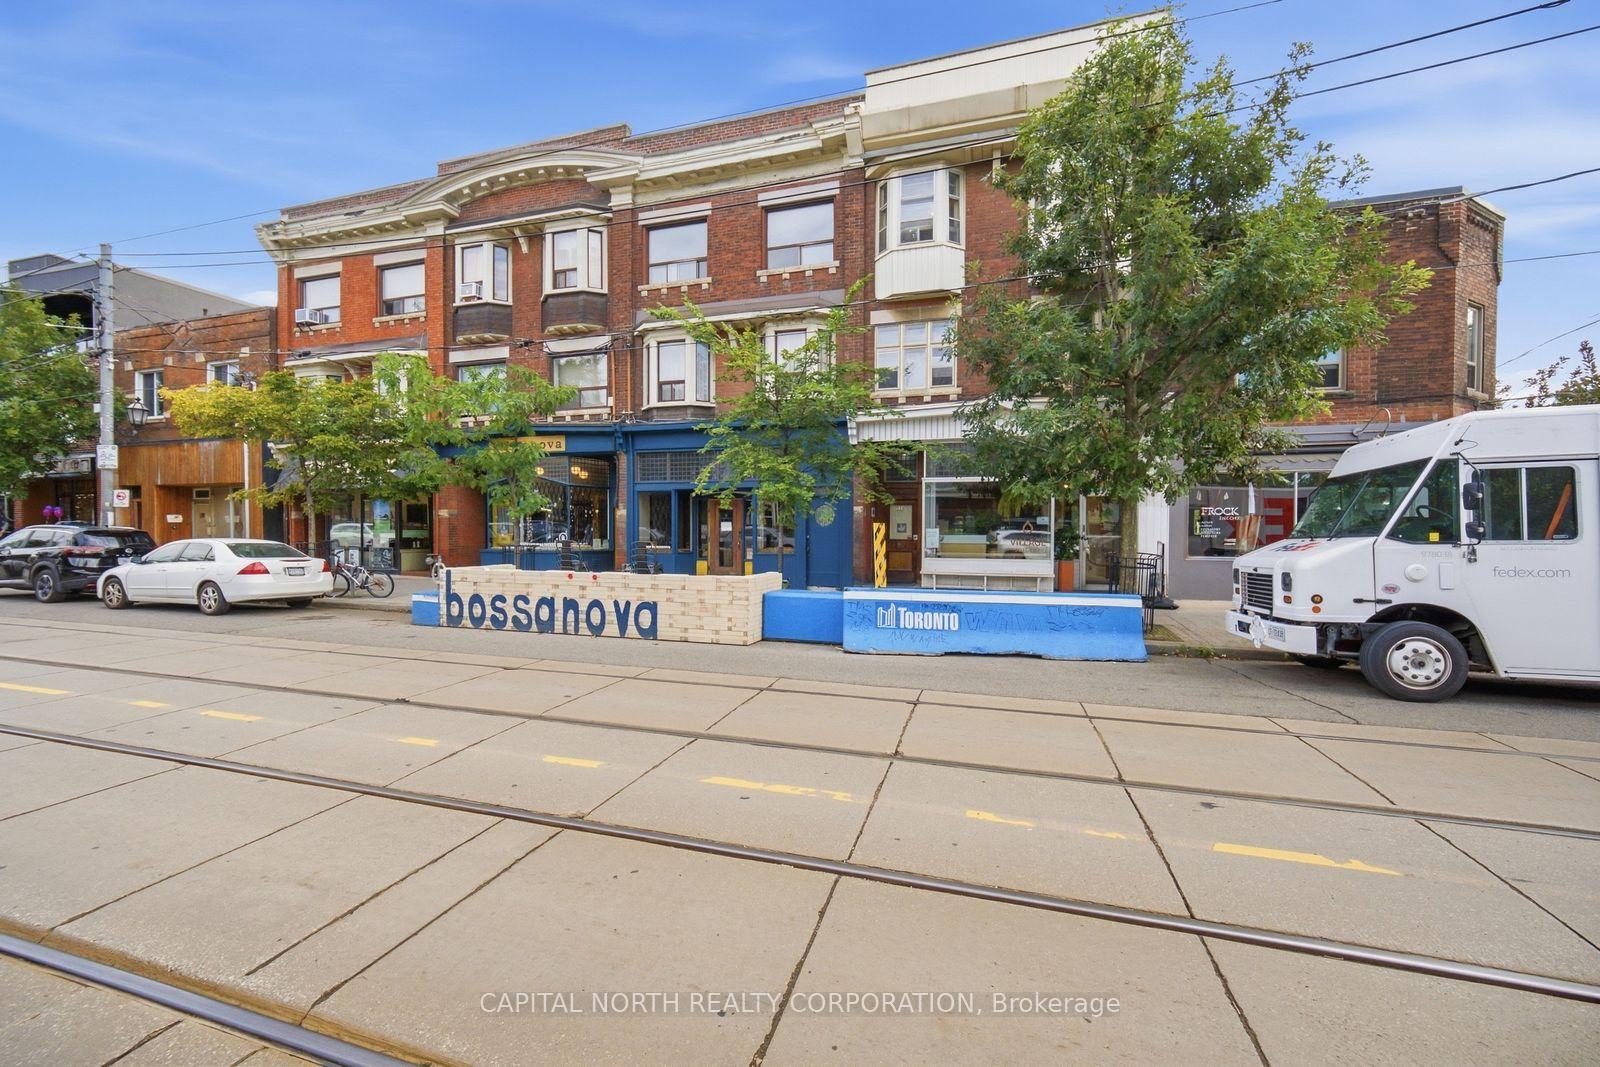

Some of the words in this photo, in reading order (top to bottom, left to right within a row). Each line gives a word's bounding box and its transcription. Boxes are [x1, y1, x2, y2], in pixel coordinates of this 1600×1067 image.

[1201, 507, 1240, 516] FROCK
[1493, 566, 1571, 578] fedex.com
[446, 569, 658, 640] bossanova
[897, 607, 959, 631] TORONTO
